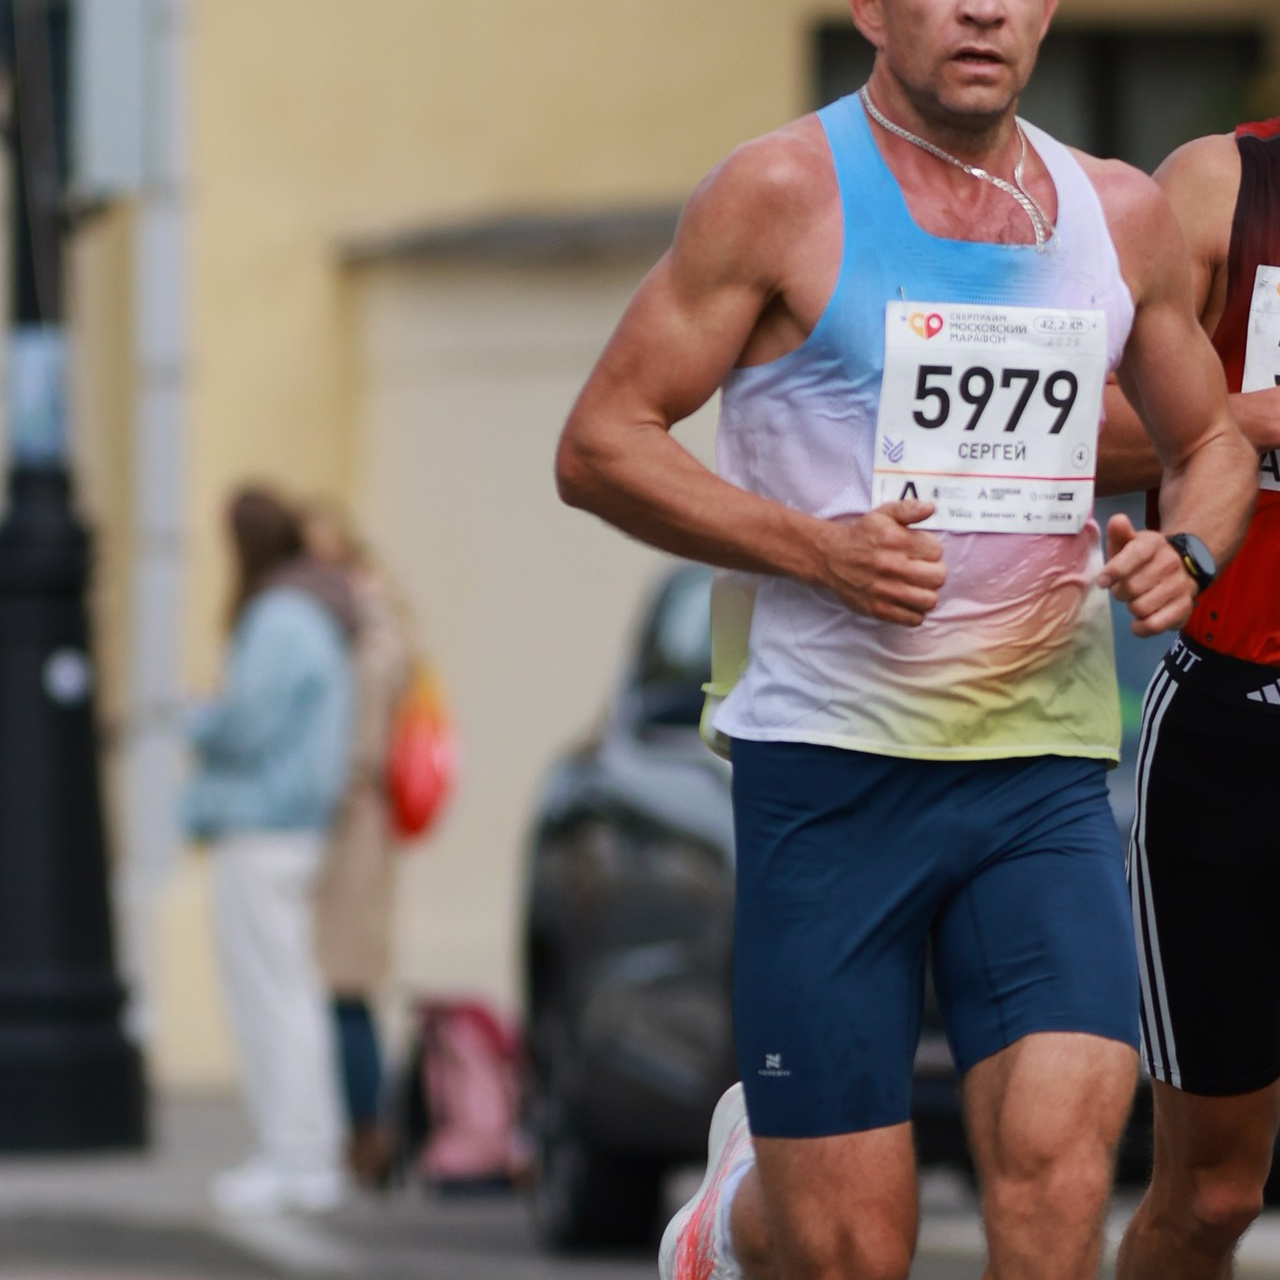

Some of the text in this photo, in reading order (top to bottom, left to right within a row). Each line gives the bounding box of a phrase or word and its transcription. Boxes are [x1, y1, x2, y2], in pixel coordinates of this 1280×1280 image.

[949, 312, 1007, 322] СБЕРПРАЙМ
[949, 322, 1028, 334] МОСКОВСКИЙ
[949, 333, 1006, 345] МАРАФОН
[911, 364, 1079, 435] 5979
[958, 440, 1027, 461] СЕРГЕЙ
